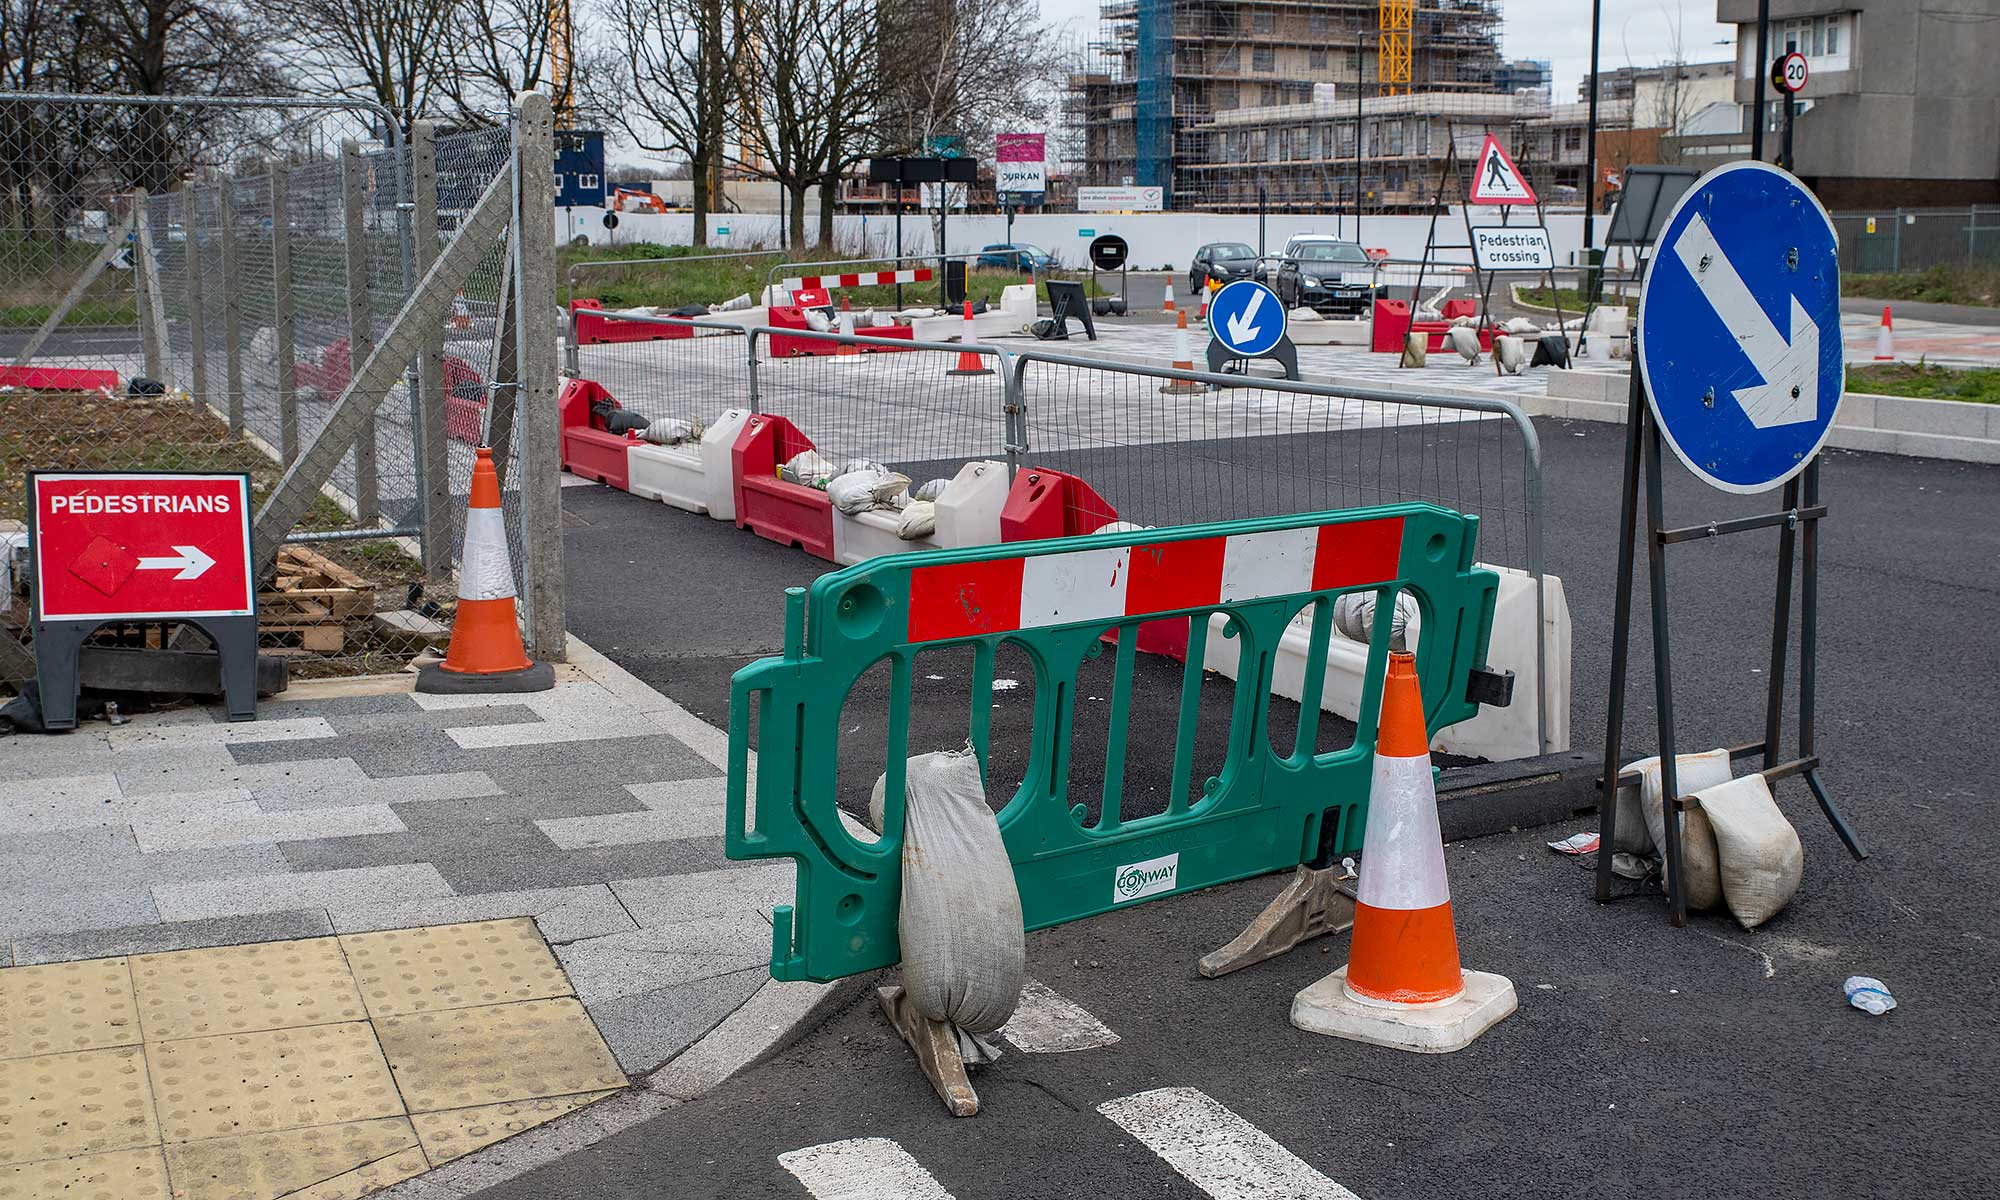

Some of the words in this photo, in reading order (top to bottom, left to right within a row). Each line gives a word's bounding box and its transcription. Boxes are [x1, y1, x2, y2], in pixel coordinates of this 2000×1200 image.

[1787, 64, 1805, 80] 20
[1480, 234, 1544, 246] Pedestrian
[1489, 250, 1540, 264] crossing
[51, 495, 231, 514] PEDESTRIANS
[1117, 864, 1176, 889] CONWAY
